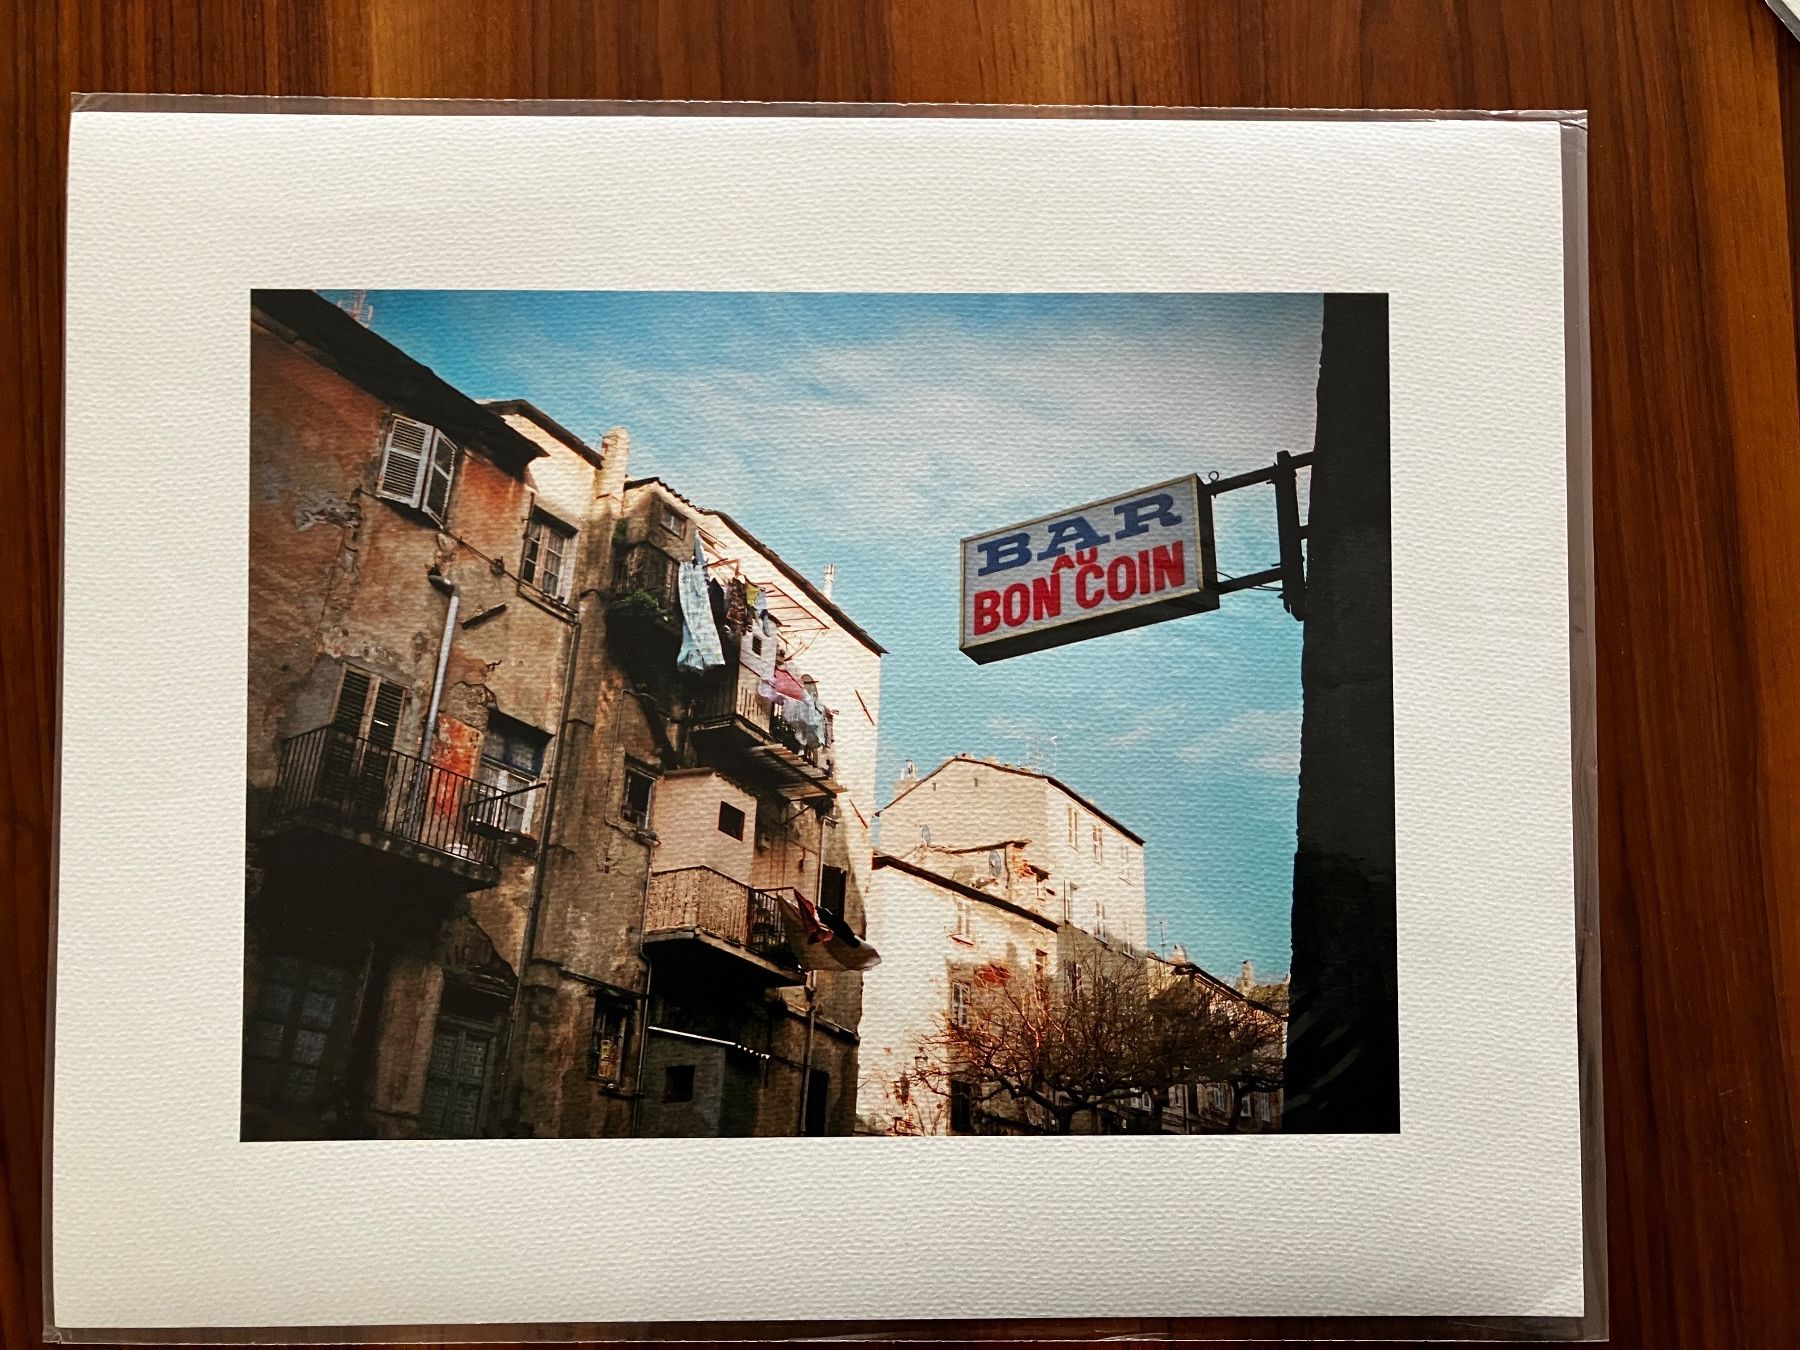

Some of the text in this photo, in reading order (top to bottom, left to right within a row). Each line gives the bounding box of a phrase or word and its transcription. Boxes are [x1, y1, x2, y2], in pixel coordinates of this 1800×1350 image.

[977, 493, 1183, 576] BAR
[1051, 546, 1098, 573] AU
[973, 540, 1186, 636] BON COIN
